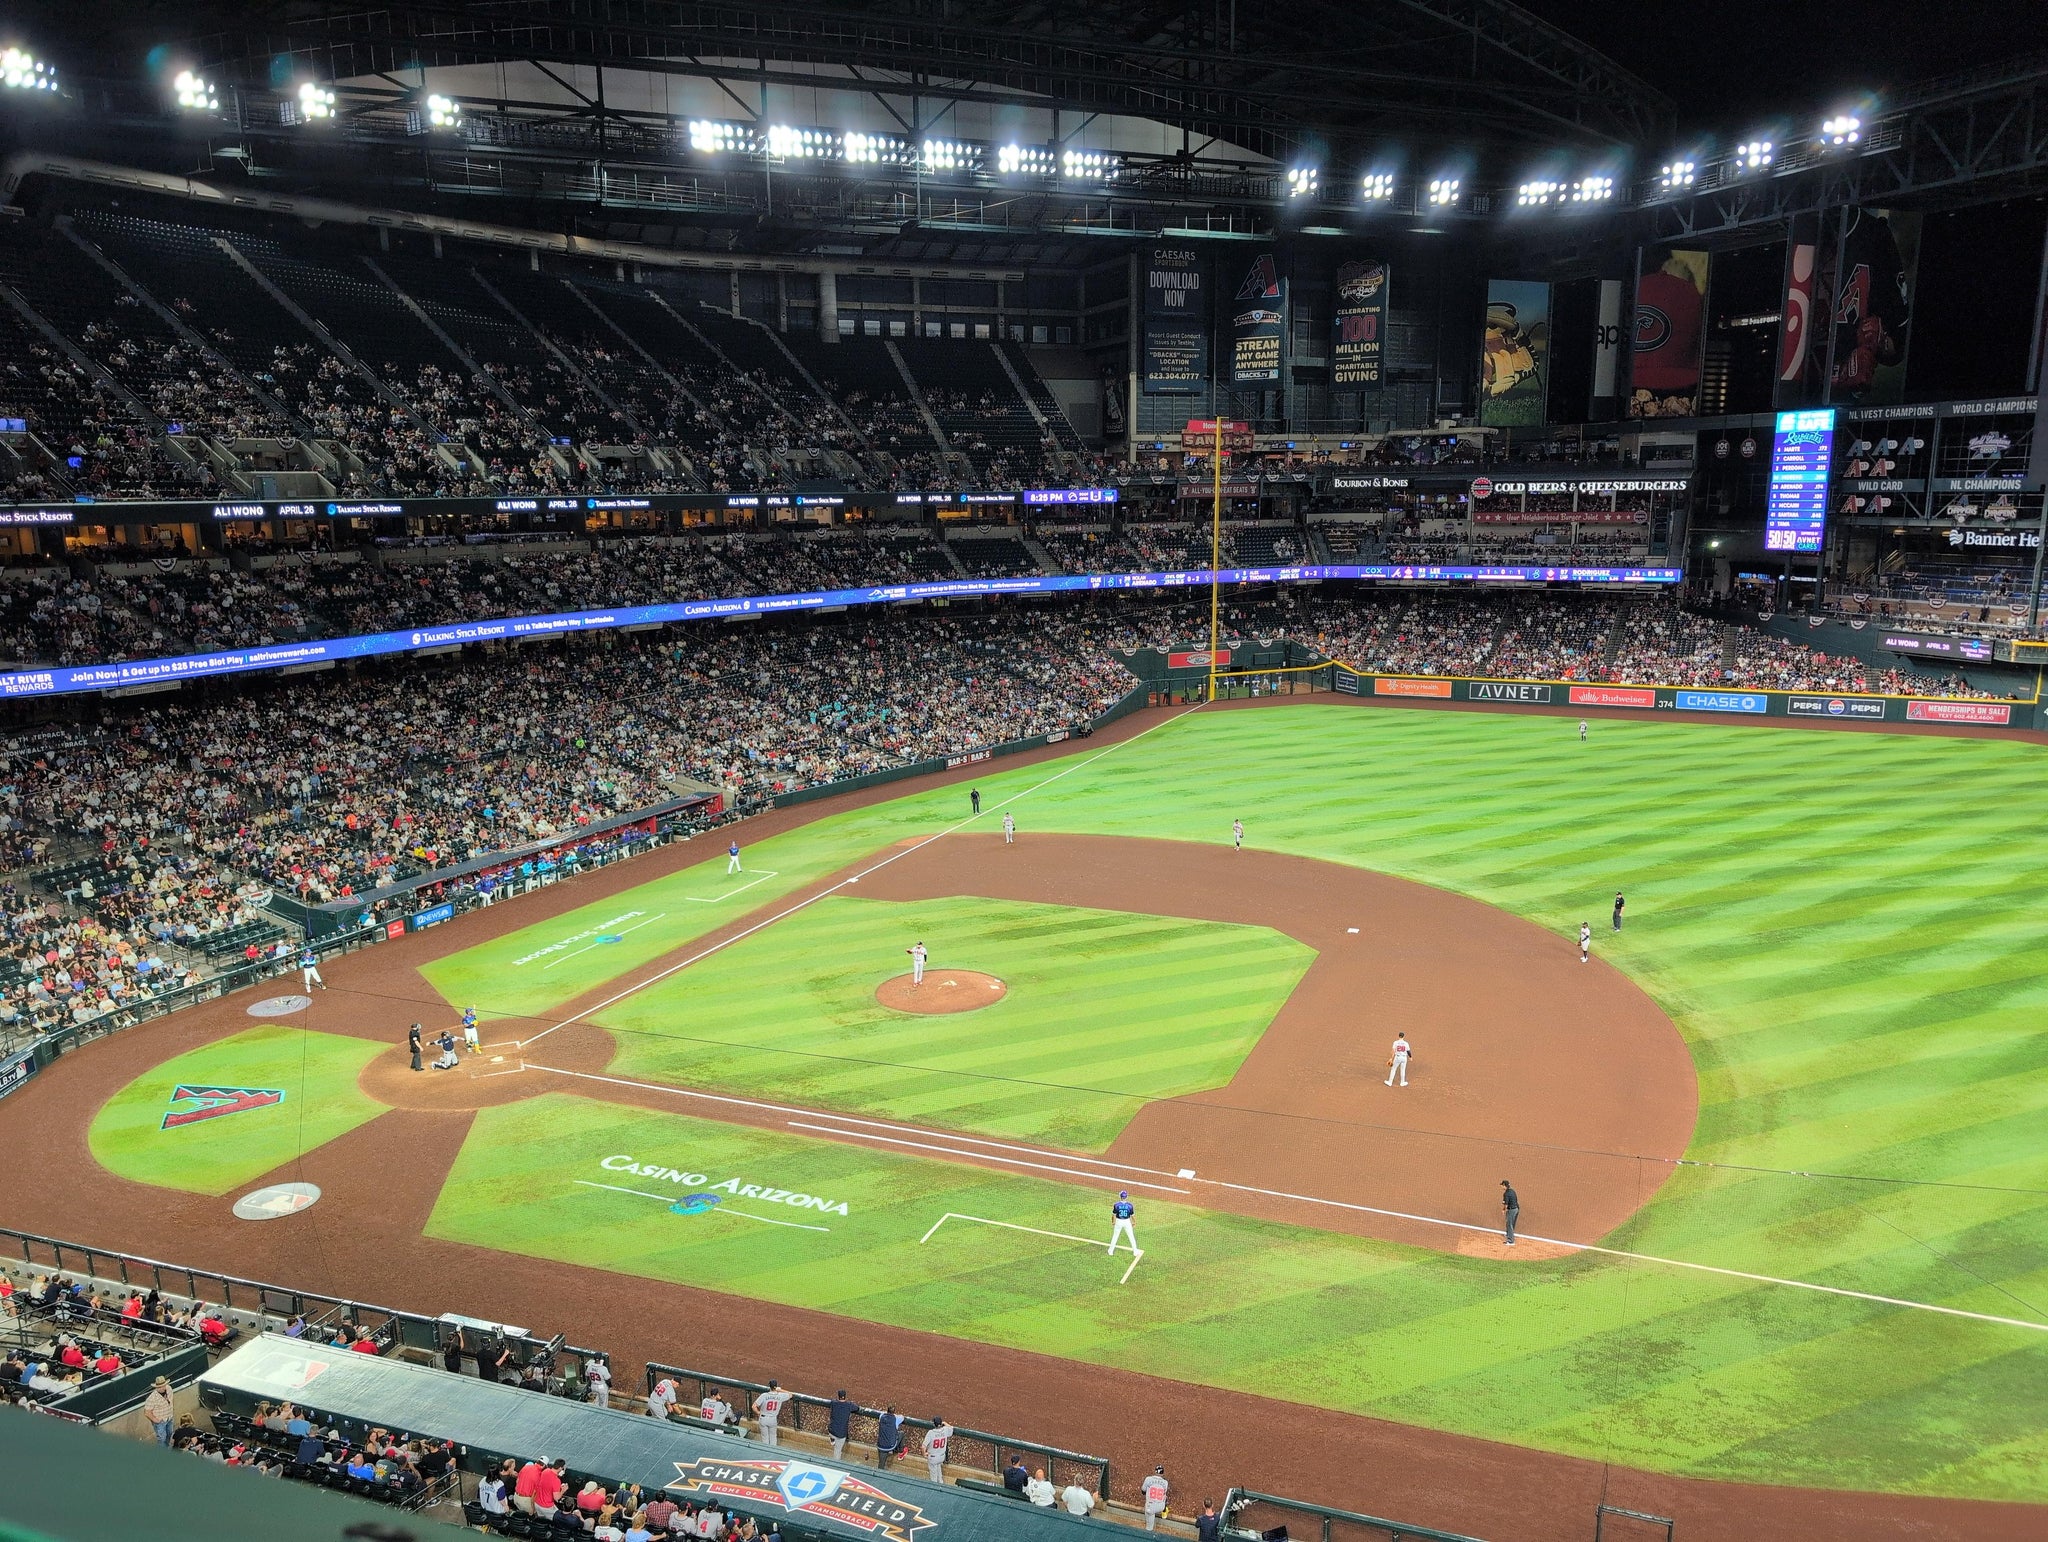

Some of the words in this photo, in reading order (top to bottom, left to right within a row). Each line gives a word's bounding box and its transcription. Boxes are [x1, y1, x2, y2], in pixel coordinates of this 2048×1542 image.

[1154, 249, 1196, 261] CAESARS
[1150, 270, 1200, 290] DOWNLOAD
[1164, 289, 1186, 308] NOW
[1336, 306, 1381, 316] CELEBRATING
[1148, 332, 1165, 340] Report
[1181, 332, 1201, 340] Conduct
[1235, 339, 1280, 351] STREAM
[1335, 342, 1380, 354] MILLION
[1235, 351, 1253, 361] ANY
[1255, 350, 1279, 360] GAME
[1352, 354, 1361, 362] IN
[1159, 358, 1190, 366] LOCATION
[1235, 359, 1279, 370] ANYWHERE
[1335, 361, 1379, 371] CHARITABLE
[1149, 372, 1200, 380] 623.304.0777
[1335, 370, 1378, 383] GIVING
[1849, 410, 1859, 419] NL
[1860, 408, 1883, 419] WEST
[1885, 406, 1934, 418] CHAMPIONS
[1952, 402, 1982, 414] WORLD
[1983, 399, 2038, 413] CHAMPIONS
[1334, 477, 1371, 488] BOURBON
[1373, 478, 1381, 488] &
[1383, 477, 1409, 488] BONES
[1494, 482, 1526, 493] COLD
[1528, 482, 1567, 492] BEERS
[1569, 482, 1578, 492] &
[1579, 480, 1687, 493] CHEESEBURGERS
[1858, 481, 1879, 491] WILD
[1880, 481, 1903, 491] CARD
[1950, 479, 1962, 490] NL
[1964, 479, 2022, 490] CHAMPIONS
[1233, 485, 1248, 494] SEATS
[729, 497, 739, 505] ALI
[740, 497, 758, 505] WONG
[767, 497, 782, 505] APRIL
[1030, 493, 1048, 502] 8:25
[1050, 493, 1063, 502] PM
[214, 506, 230, 517] ALI
[232, 506, 264, 516] WONG
[279, 505, 302, 515] APRIL
[336, 505, 361, 514] TALKING
[362, 504, 378, 513] STICK
[379, 504, 401, 513] RESORT
[497, 501, 510, 510] ALI
[512, 501, 537, 510] WONG
[549, 500, 568, 509] APRIL
[14, 512, 39, 522] STICK
[40, 511, 74, 522] RESORT
[1506, 513, 1520, 522] Your
[1521, 513, 1560, 521] Neighborhood
[1560, 513, 1582, 522] Burger
[1583, 513, 1599, 522] Joint
[1965, 531, 2015, 546] Banner
[685, 605, 711, 616] CASINO
[712, 603, 742, 613] ARIZONA
[422, 631, 455, 643] TALKING
[456, 629, 477, 639] STICK
[477, 625, 506, 637] RESORT
[1886, 638, 1897, 646] ALI
[1898, 639, 1919, 648] WONG
[1926, 642, 1941, 650] APRIL
[70, 671, 94, 682] Join
[95, 668, 121, 680] Now
[122, 668, 130, 678] &
[131, 667, 146, 677] Get
[148, 666, 158, 677] up
[159, 663, 170, 673] to
[189, 658, 208, 670] Free
[209, 657, 225, 668] Slot
[225, 655, 244, 667] Play
[249, 646, 326, 663] saltriverrewards.com
[17, 673, 52, 684] RIVER
[5, 681, 54, 693] REWARDS
[1400, 683, 1420, 692] Dignity
[1420, 683, 1439, 692] Health
[1478, 685, 1542, 700] AVNET
[1601, 693, 1647, 704] Budweiser
[1658, 700, 1673, 709] 374
[1686, 695, 1739, 708] CHASE
[1793, 701, 1822, 710] PEPSI
[1851, 703, 1881, 713] PEPSI
[1928, 705, 1975, 716] MEMBERSHIPS
[1977, 706, 1987, 715] ON
[1989, 707, 2006, 716] SALE
[947, 755, 968, 767] BAR-S
[970, 750, 990, 763] BAR-S
[424, 910, 442, 921] NEWS
[600, 1155, 708, 1186] CASINO
[709, 1177, 849, 1216] ARIZONA
[1118, 1209, 1128, 1217] 36
[765, 1400, 779, 1412] 81
[702, 1407, 715, 1420] 85
[932, 1438, 946, 1449] 80
[701, 1465, 772, 1486] CHASE
[835, 1492, 906, 1521] FIELD
[714, 1484, 735, 1495] HOME
[745, 1489, 757, 1497] OF
[762, 1493, 779, 1502] THE
[808, 1504, 874, 1527] DIAMONDBACKS
[699, 1519, 709, 1532] 4
